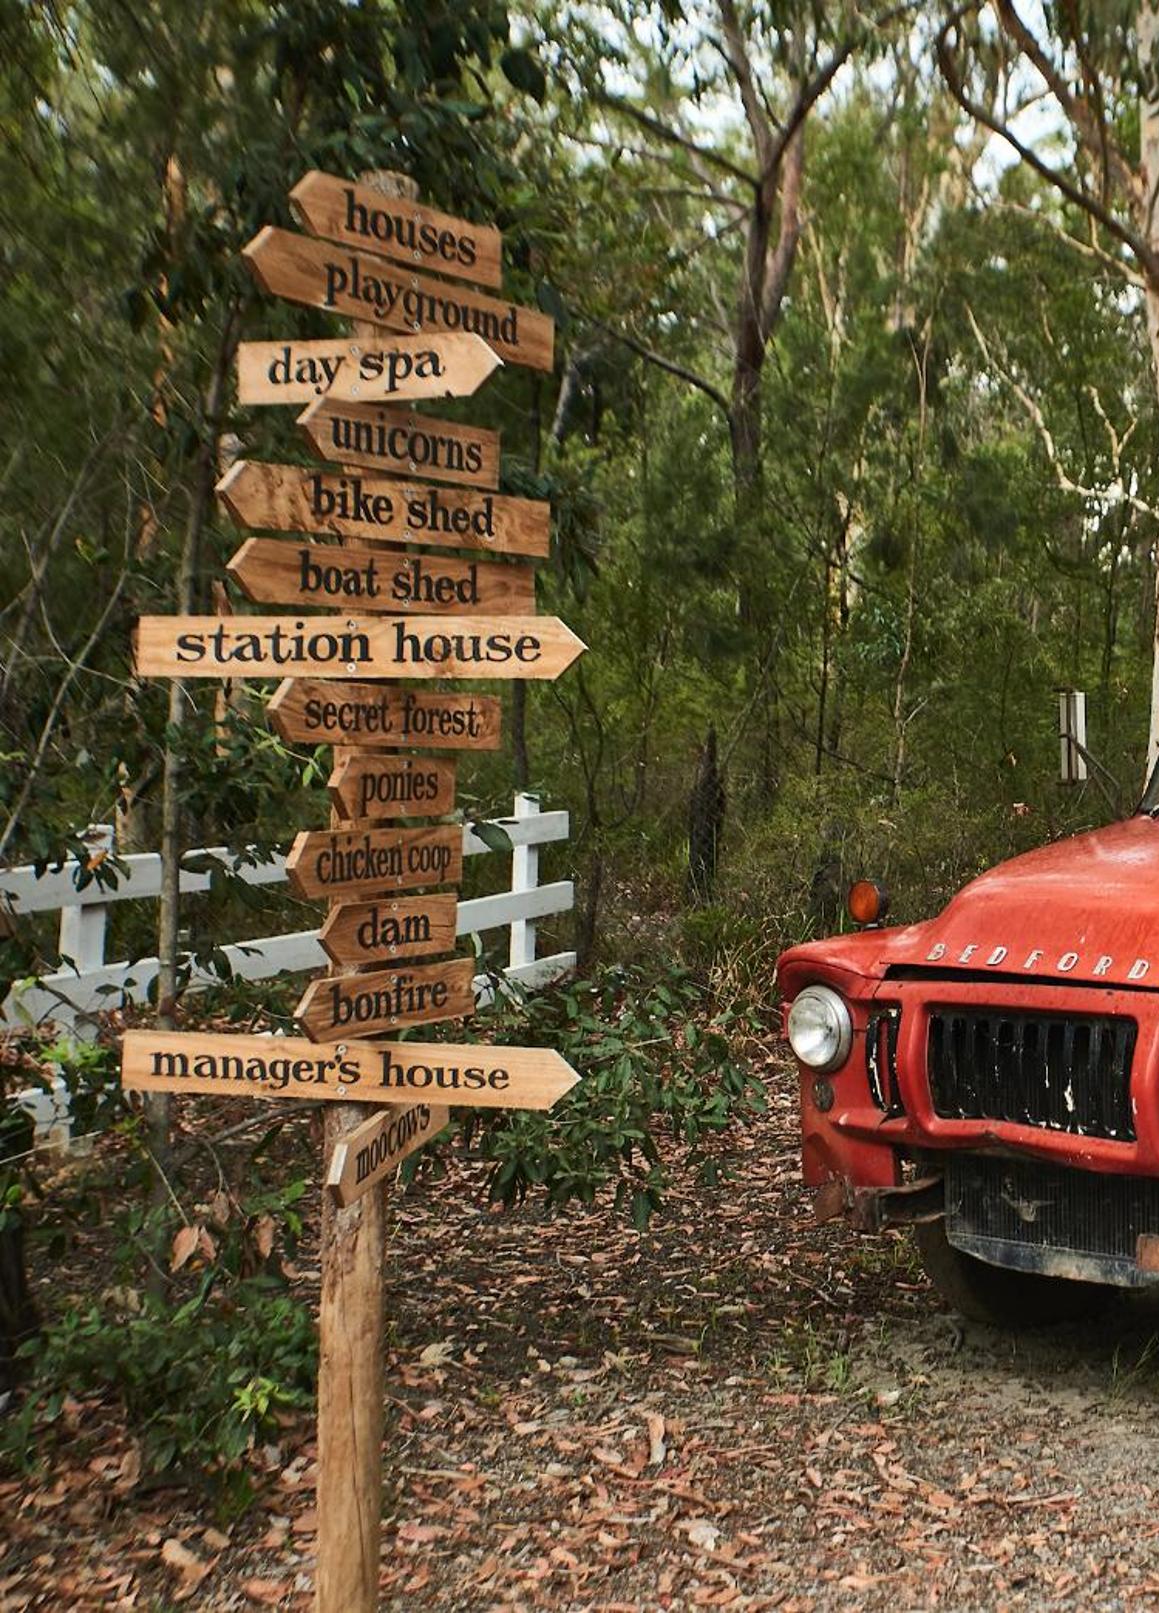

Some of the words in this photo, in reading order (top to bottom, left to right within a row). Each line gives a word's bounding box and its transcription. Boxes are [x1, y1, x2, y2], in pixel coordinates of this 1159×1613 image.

[344, 189, 477, 266] houses
[324, 258, 519, 345] playground
[268, 347, 346, 394] day
[359, 349, 446, 393] spa
[330, 411, 482, 474] unicorns
[311, 475, 393, 525] bike
[407, 490, 495, 537] shed
[299, 549, 380, 598] boat
[392, 560, 480, 605] shed
[176, 621, 373, 663] station
[392, 622, 541, 662] house
[304, 698, 392, 732] secret
[401, 698, 480, 738] forest
[359, 764, 438, 817] ponies
[316, 835, 402, 884] chicken
[408, 842, 451, 882] coop
[357, 907, 432, 949] dam
[926, 943, 1149, 979] BEDFORD
[329, 975, 448, 1026] bonfire
[150, 1051, 361, 1090] manager's
[378, 1051, 510, 1090] house
[356, 1103, 430, 1185] moocows
